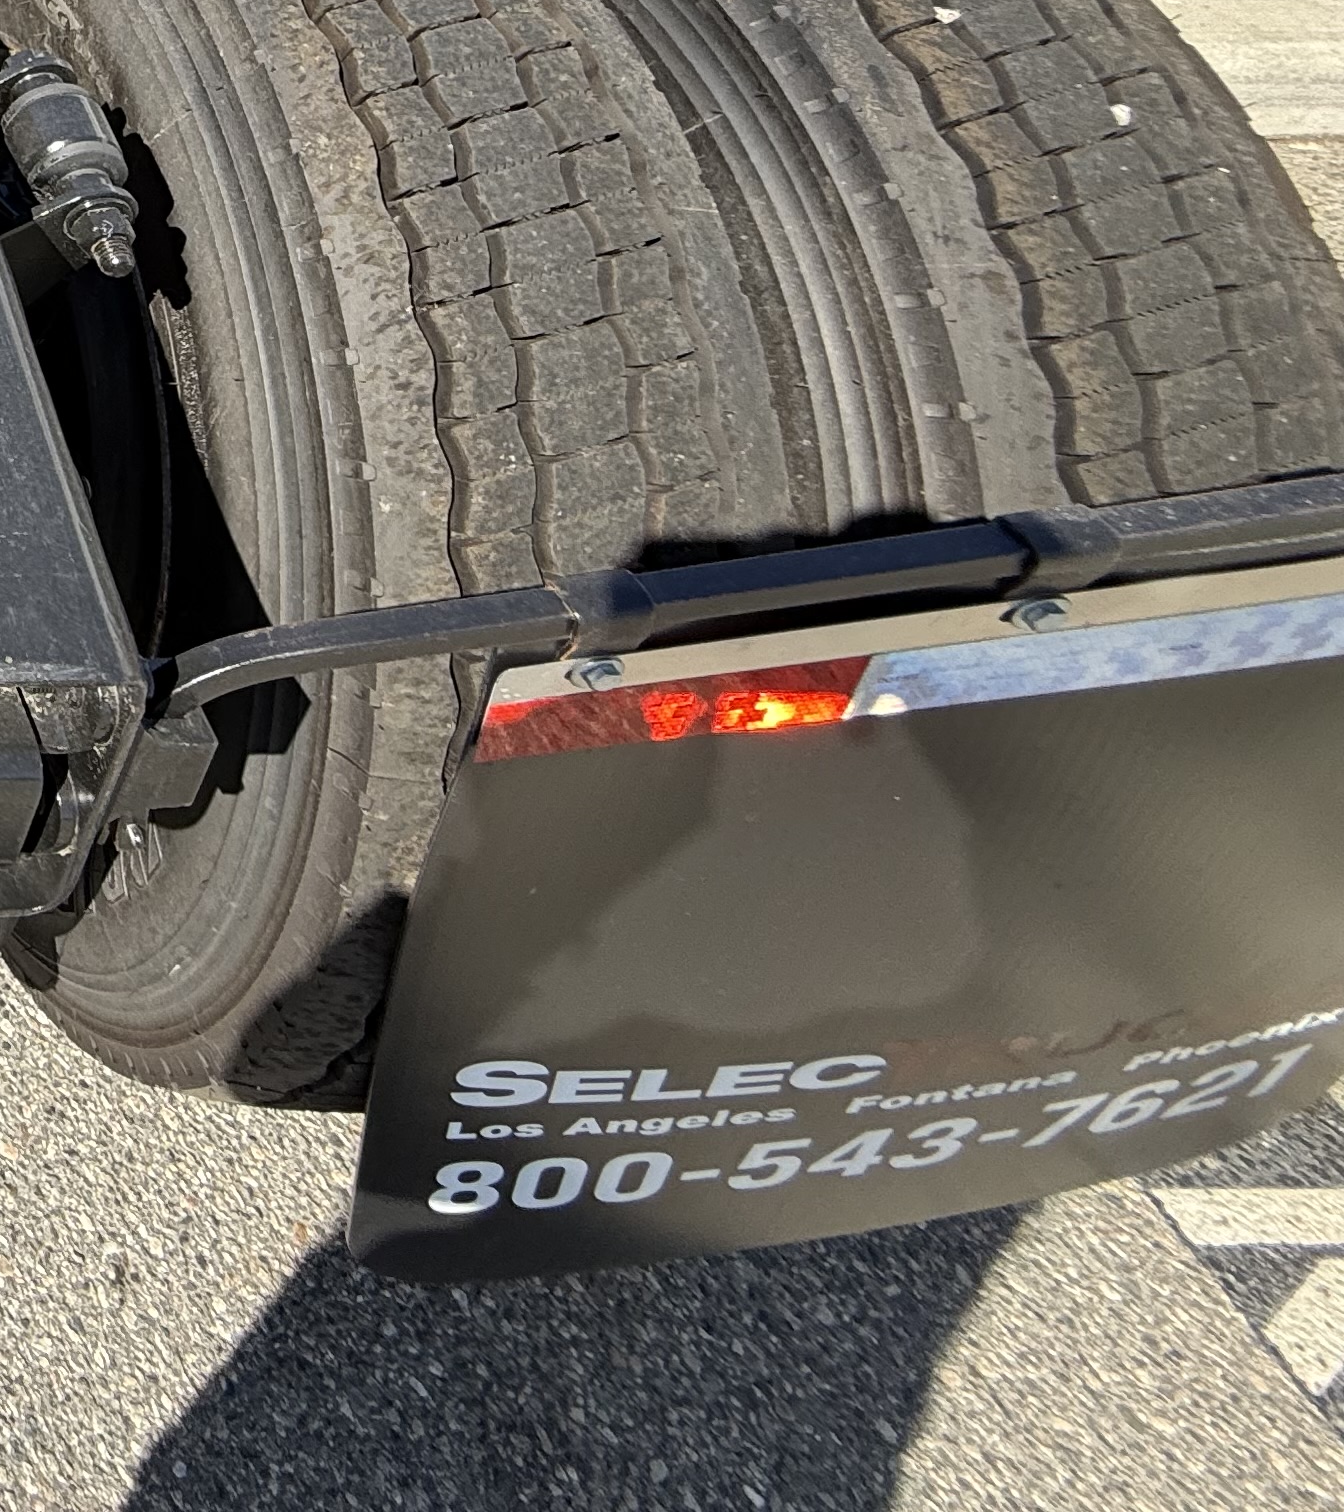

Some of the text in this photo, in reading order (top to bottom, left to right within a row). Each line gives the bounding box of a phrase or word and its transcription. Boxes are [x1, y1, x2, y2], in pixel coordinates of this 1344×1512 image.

[427, 1044, 1313, 1216] 800-543-7621
[446, 1120, 546, 1141] Los
[563, 1107, 797, 1139] Angeles
[846, 1069, 1077, 1114] Fontana
[1123, 1007, 1344, 1071] Phoenix
